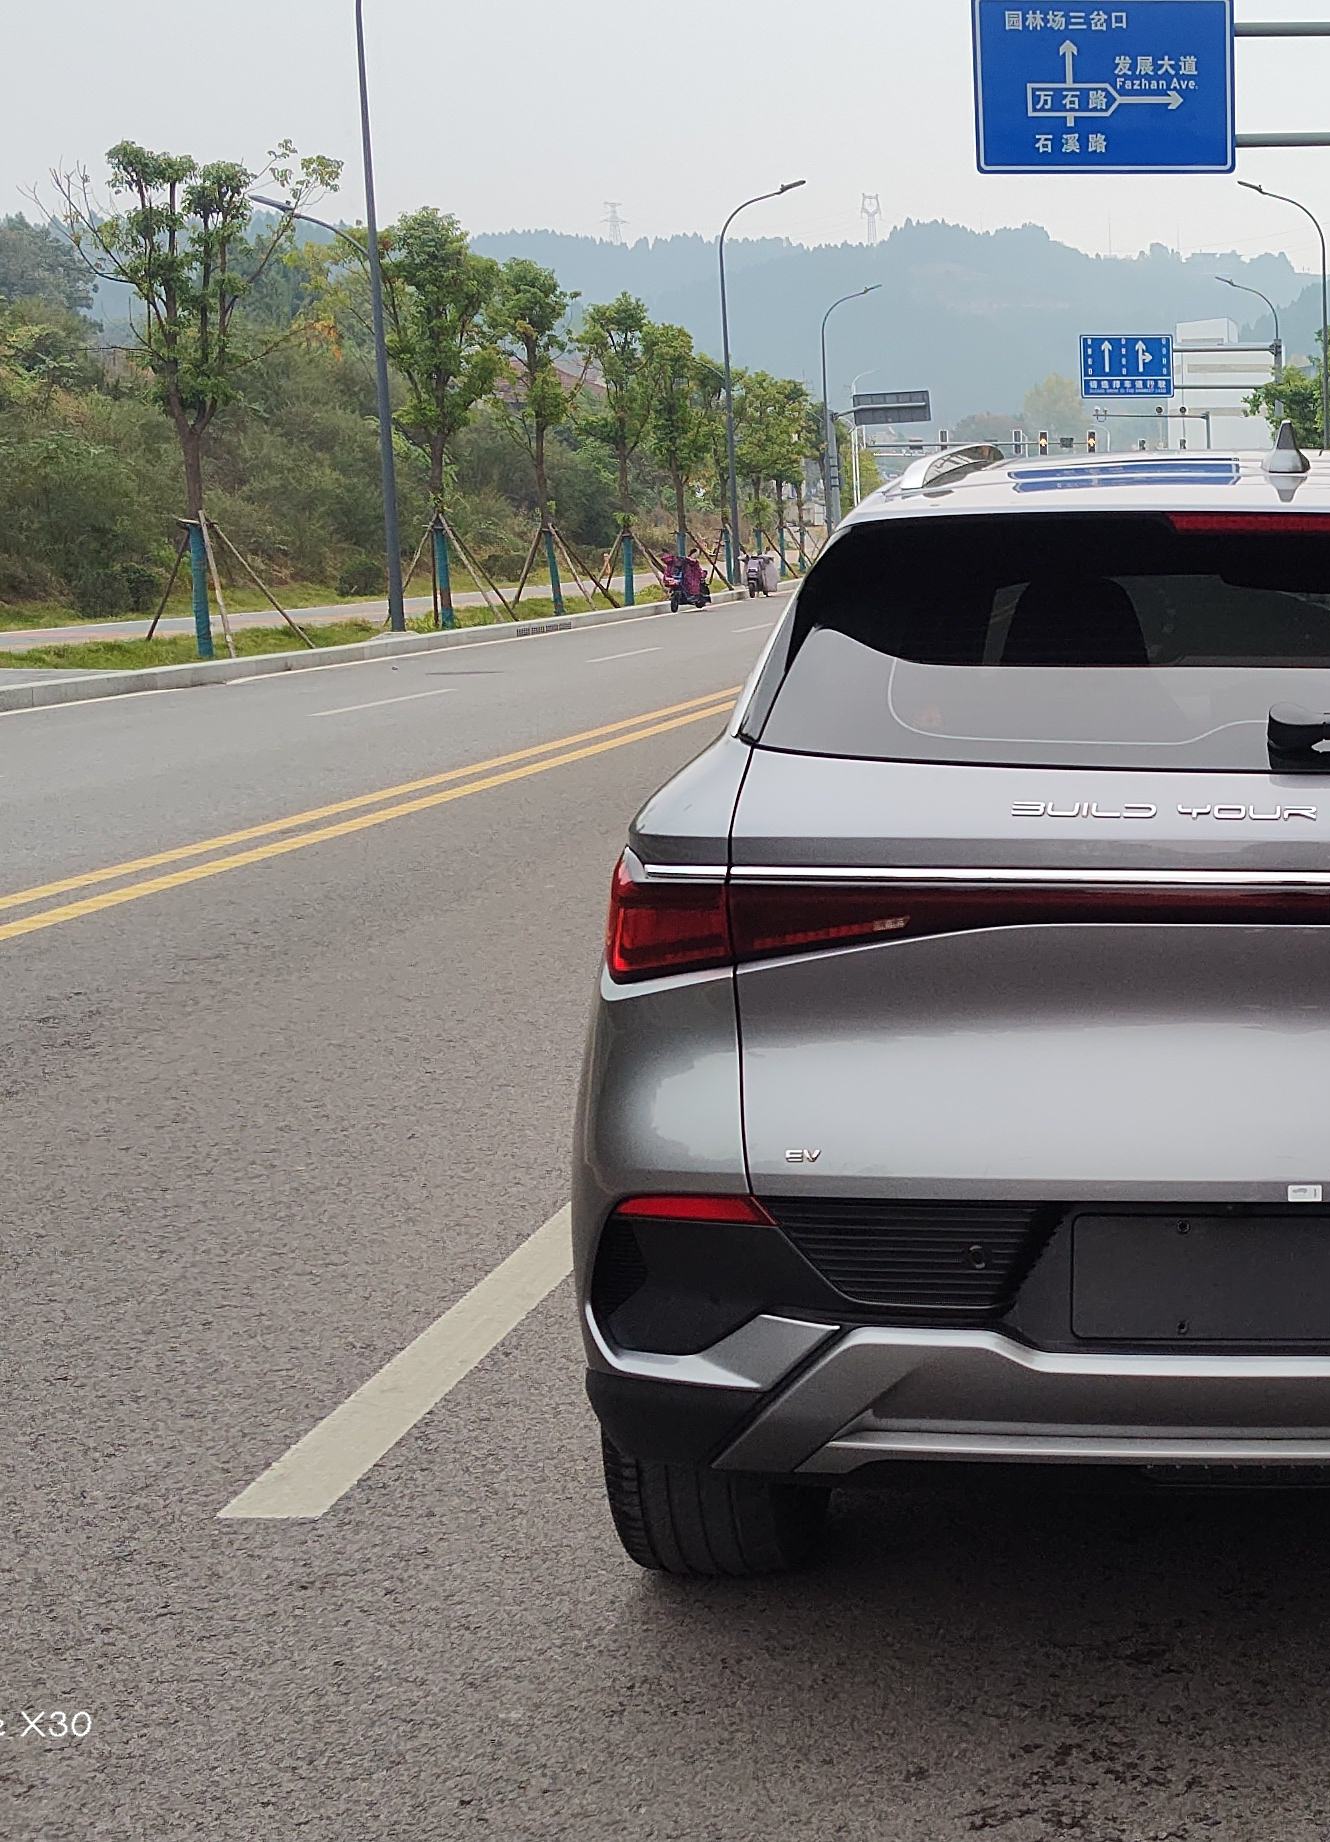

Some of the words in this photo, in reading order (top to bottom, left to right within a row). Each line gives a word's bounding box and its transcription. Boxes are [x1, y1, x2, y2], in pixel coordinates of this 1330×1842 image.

[1004, 10, 1128, 31] 园林场三岔口
[1114, 55, 1198, 75] 发展大道
[1116, 77, 1167, 90] Fazhan
[1170, 77, 1199, 90] Ave.
[1035, 91, 1108, 109] 万石路
[1035, 133, 1108, 153] 石溪路
[1011, 800, 1158, 819] BUILD
[1177, 803, 1318, 822] YOUR
[785, 1149, 822, 1163] EV
